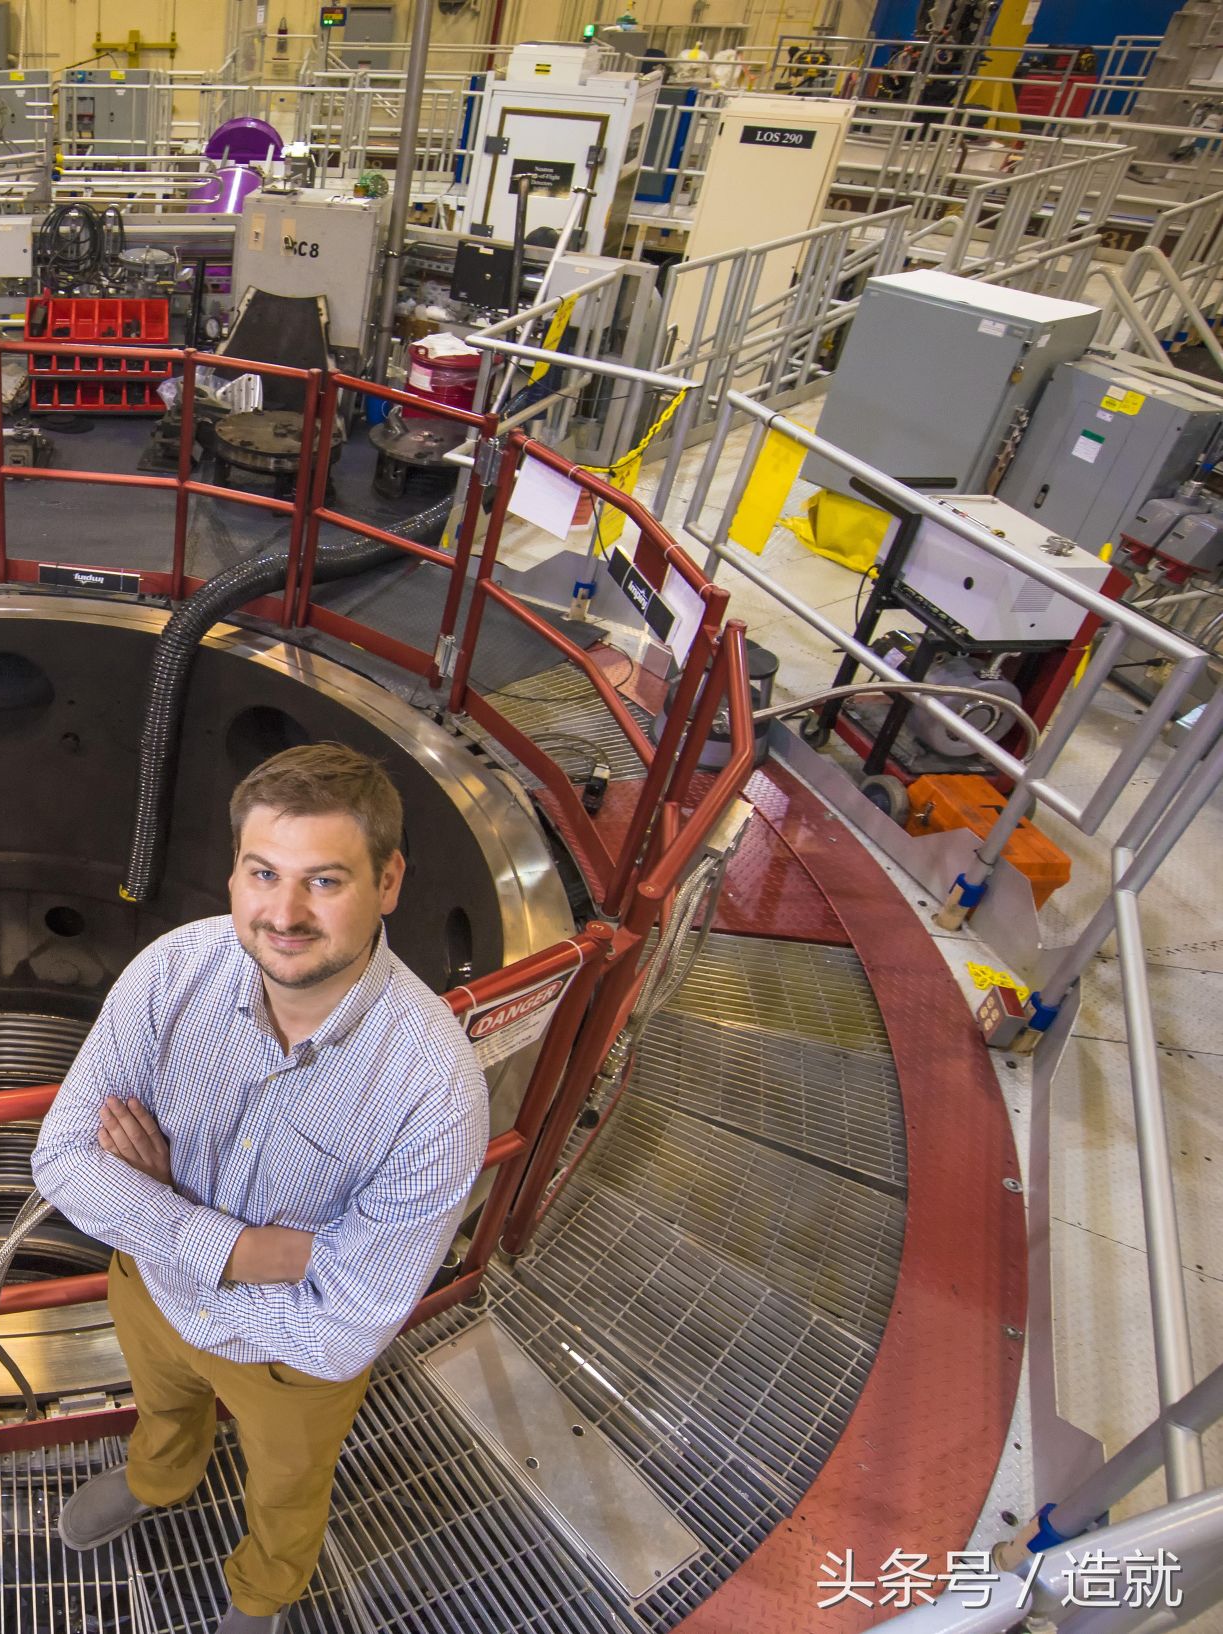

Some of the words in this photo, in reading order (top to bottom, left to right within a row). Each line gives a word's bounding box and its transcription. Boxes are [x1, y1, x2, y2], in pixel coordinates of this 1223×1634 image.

[755, 130, 781, 143] LOS
[781, 133, 803, 145] 290
[309, 242, 319, 258] 8
[476, 983, 558, 1035] DANGER
